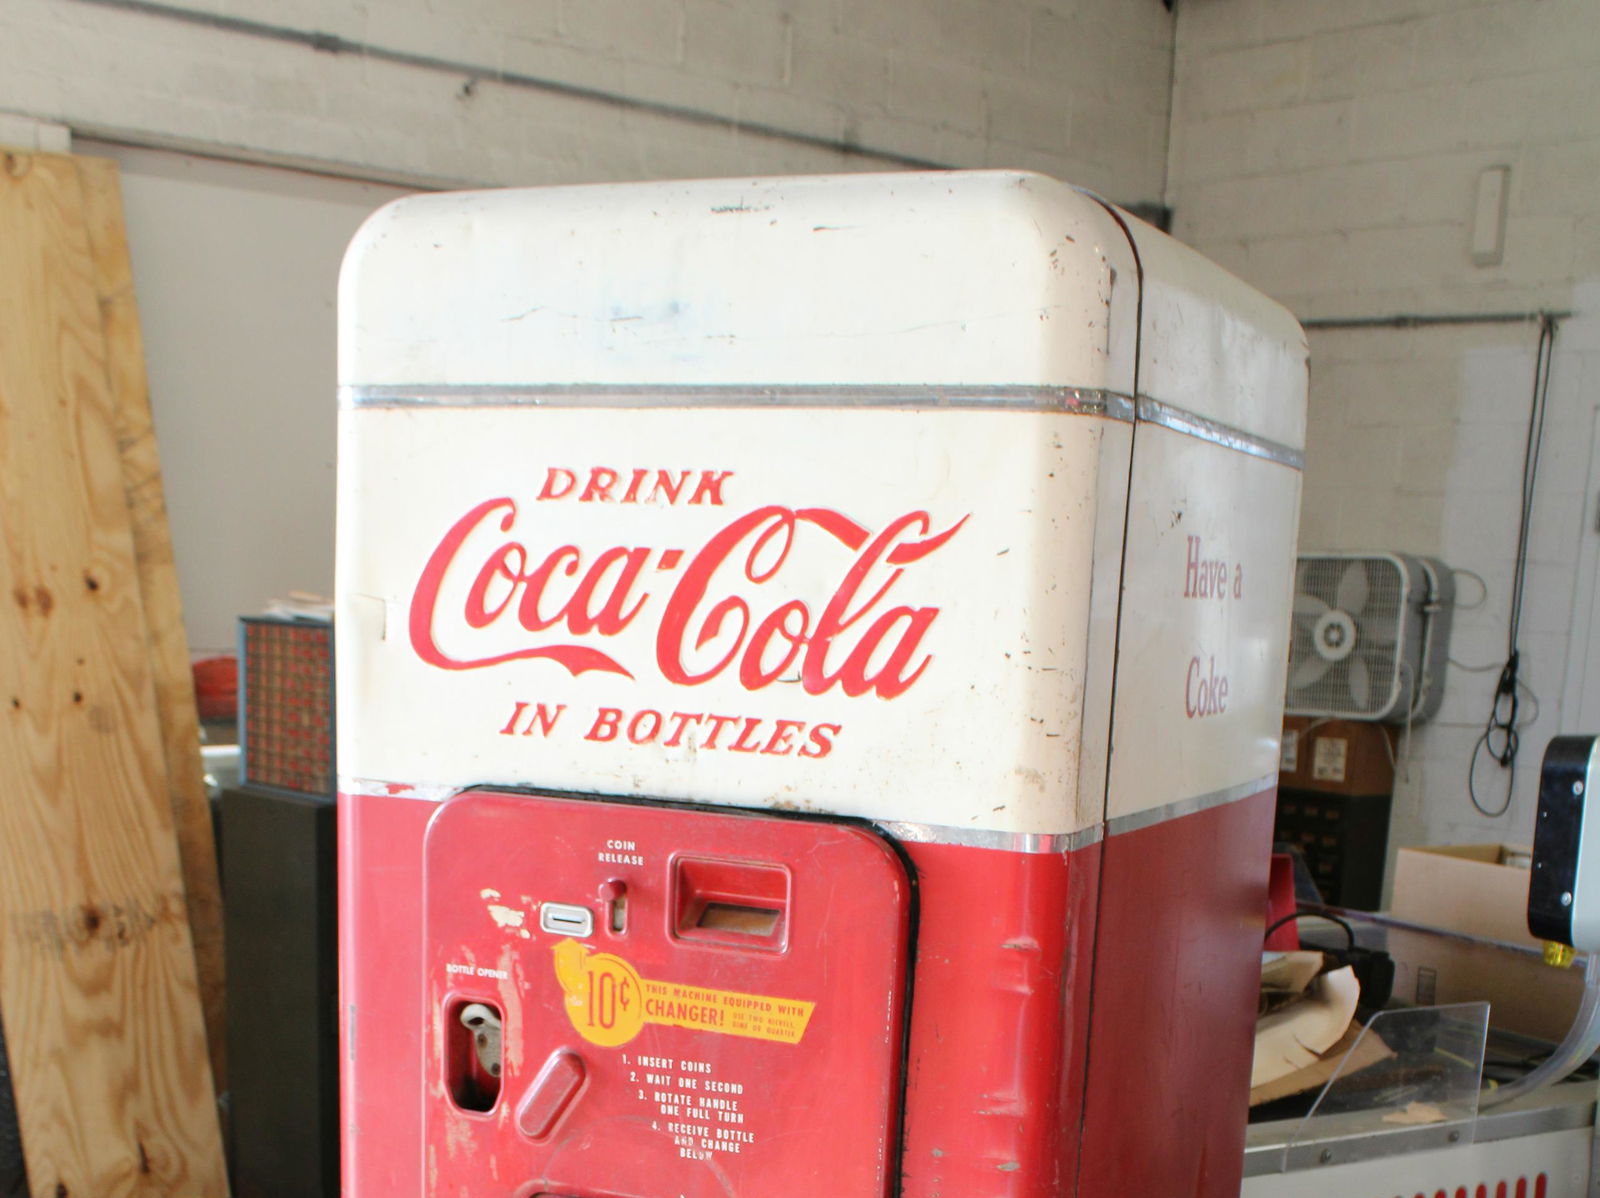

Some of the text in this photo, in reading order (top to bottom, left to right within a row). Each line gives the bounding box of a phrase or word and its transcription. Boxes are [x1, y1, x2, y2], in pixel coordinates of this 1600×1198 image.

[536, 467, 735, 506] DRINK
[1184, 535, 1244, 600] Have a
[408, 497, 971, 700] Coca-Cola
[1185, 655, 1229, 719] Coke
[499, 702, 842, 759] IN BOTTLES
[606, 839, 636, 851] COIN
[597, 852, 645, 866] RELEASE
[446, 963, 509, 980] BOTTLE OPENER
[645, 983, 805, 1018] THIS MACHINE EQUIPPED WITH
[645, 998, 726, 1028] CHANGER!
[622, 1054, 712, 1074] 1. INSERT COINS
[630, 1071, 744, 1095] 2. WAIT ONE SECOND
[638, 1089, 738, 1112] 3. ROTATE HANDLE
[660, 1104, 744, 1124] ONE FULL TURN
[652, 1121, 755, 1143] 4. RECEIVE BOTTLE
[674, 1135, 741, 1153] AND CHANGE
[680, 1147, 713, 1161] BELOW
